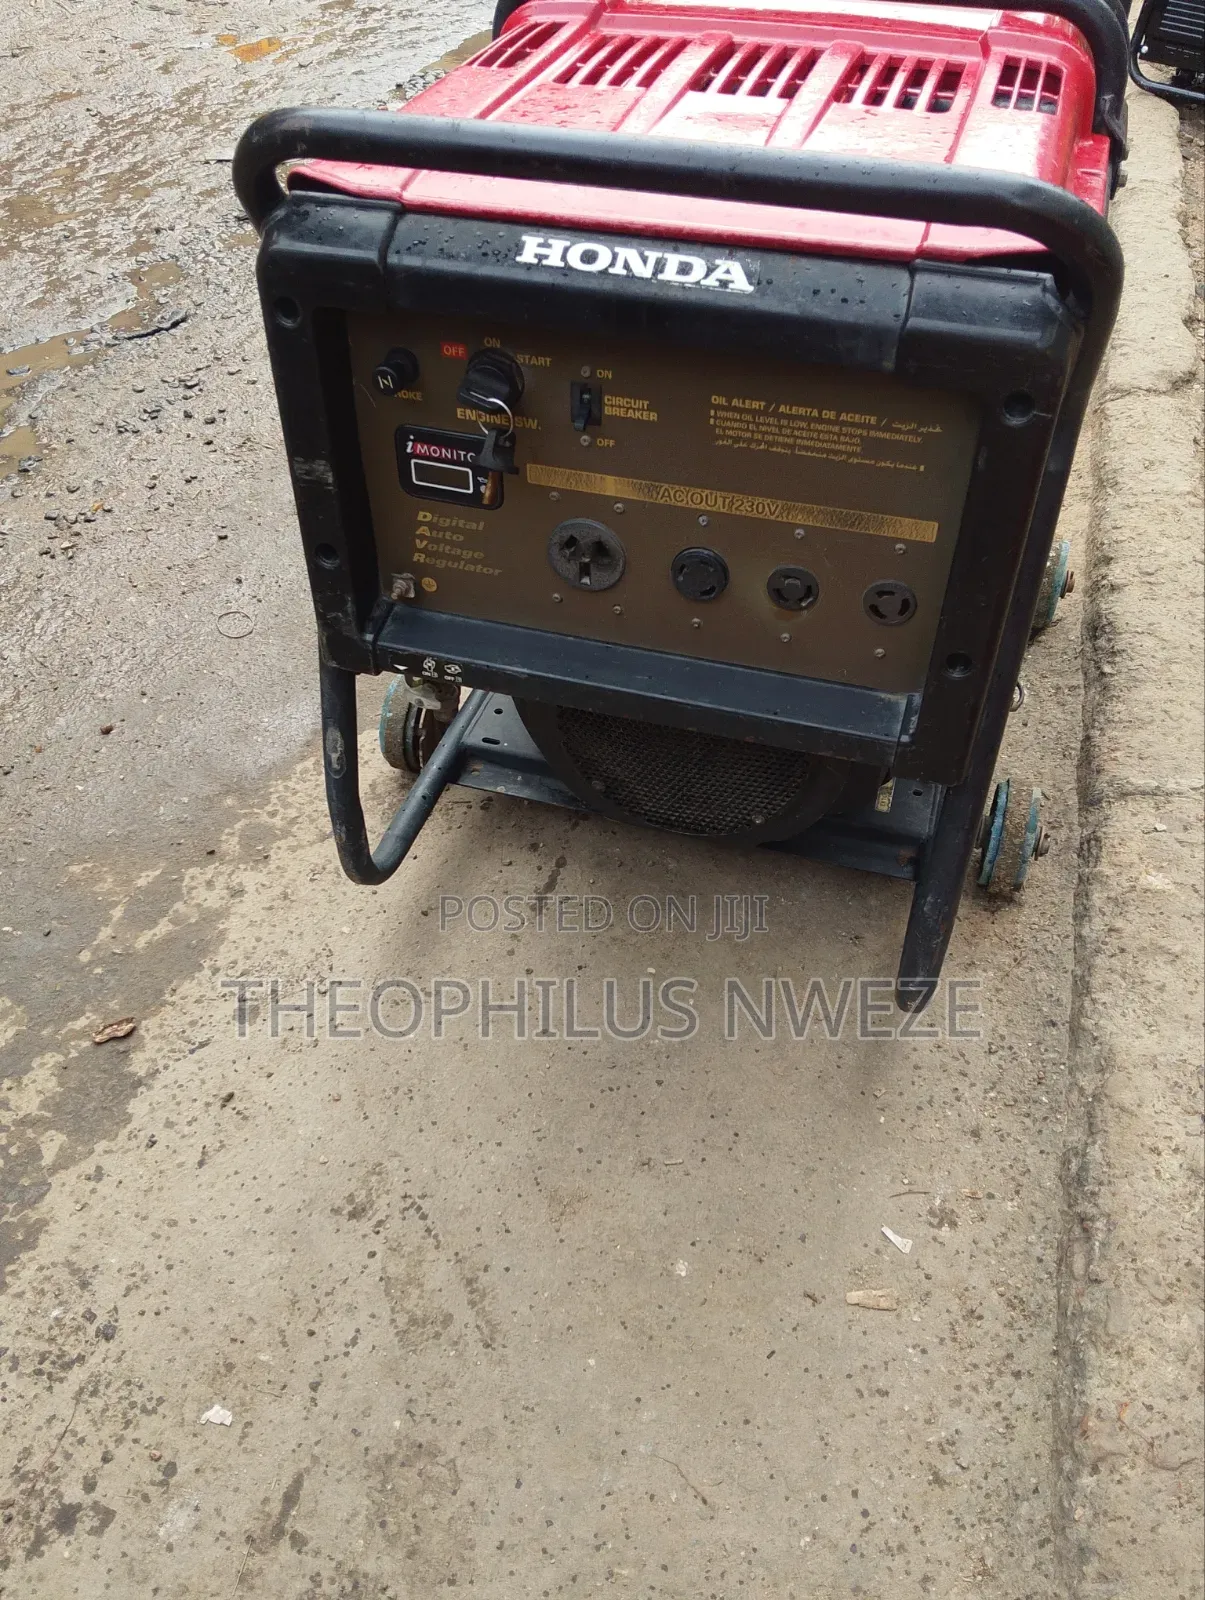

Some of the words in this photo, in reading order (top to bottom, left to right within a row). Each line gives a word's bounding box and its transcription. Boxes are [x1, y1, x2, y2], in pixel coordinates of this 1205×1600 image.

[515, 234, 755, 294] HONDA
[443, 345, 465, 356] OFF
[483, 337, 500, 348] ON
[516, 354, 552, 367] START
[596, 369, 612, 379] ON
[604, 395, 650, 410] CIRCUIT
[711, 395, 728, 406] OIL
[731, 398, 766, 411] ALERT
[779, 404, 819, 418] ALERTA
[822, 410, 836, 420] DE
[840, 412, 877, 425] ACEITE
[456, 408, 509, 426] ENGINE
[514, 416, 542, 430] SW.
[604, 406, 658, 422] BREAKER
[716, 410, 740, 421] WHEN
[741, 413, 755, 423] OIL
[756, 415, 779, 426] LEVEL
[810, 423, 841, 434] ENGINE
[842, 426, 868, 437] STOPS
[716, 420, 748, 430] CUANDO
[759, 425, 780, 435] NIVEL
[782, 428, 792, 437] DE
[793, 430, 818, 440] ACEITE
[596, 438, 616, 448] OFF
[725, 429, 752, 439] MOTOR
[660, 487, 685, 503] AC
[690, 491, 729, 509] OUT
[735, 500, 780, 517] 230V
[417, 511, 485, 531] Digital
[415, 525, 464, 542] Auto
[415, 538, 485, 559] Voltage
[413, 552, 502, 576] Regulator
